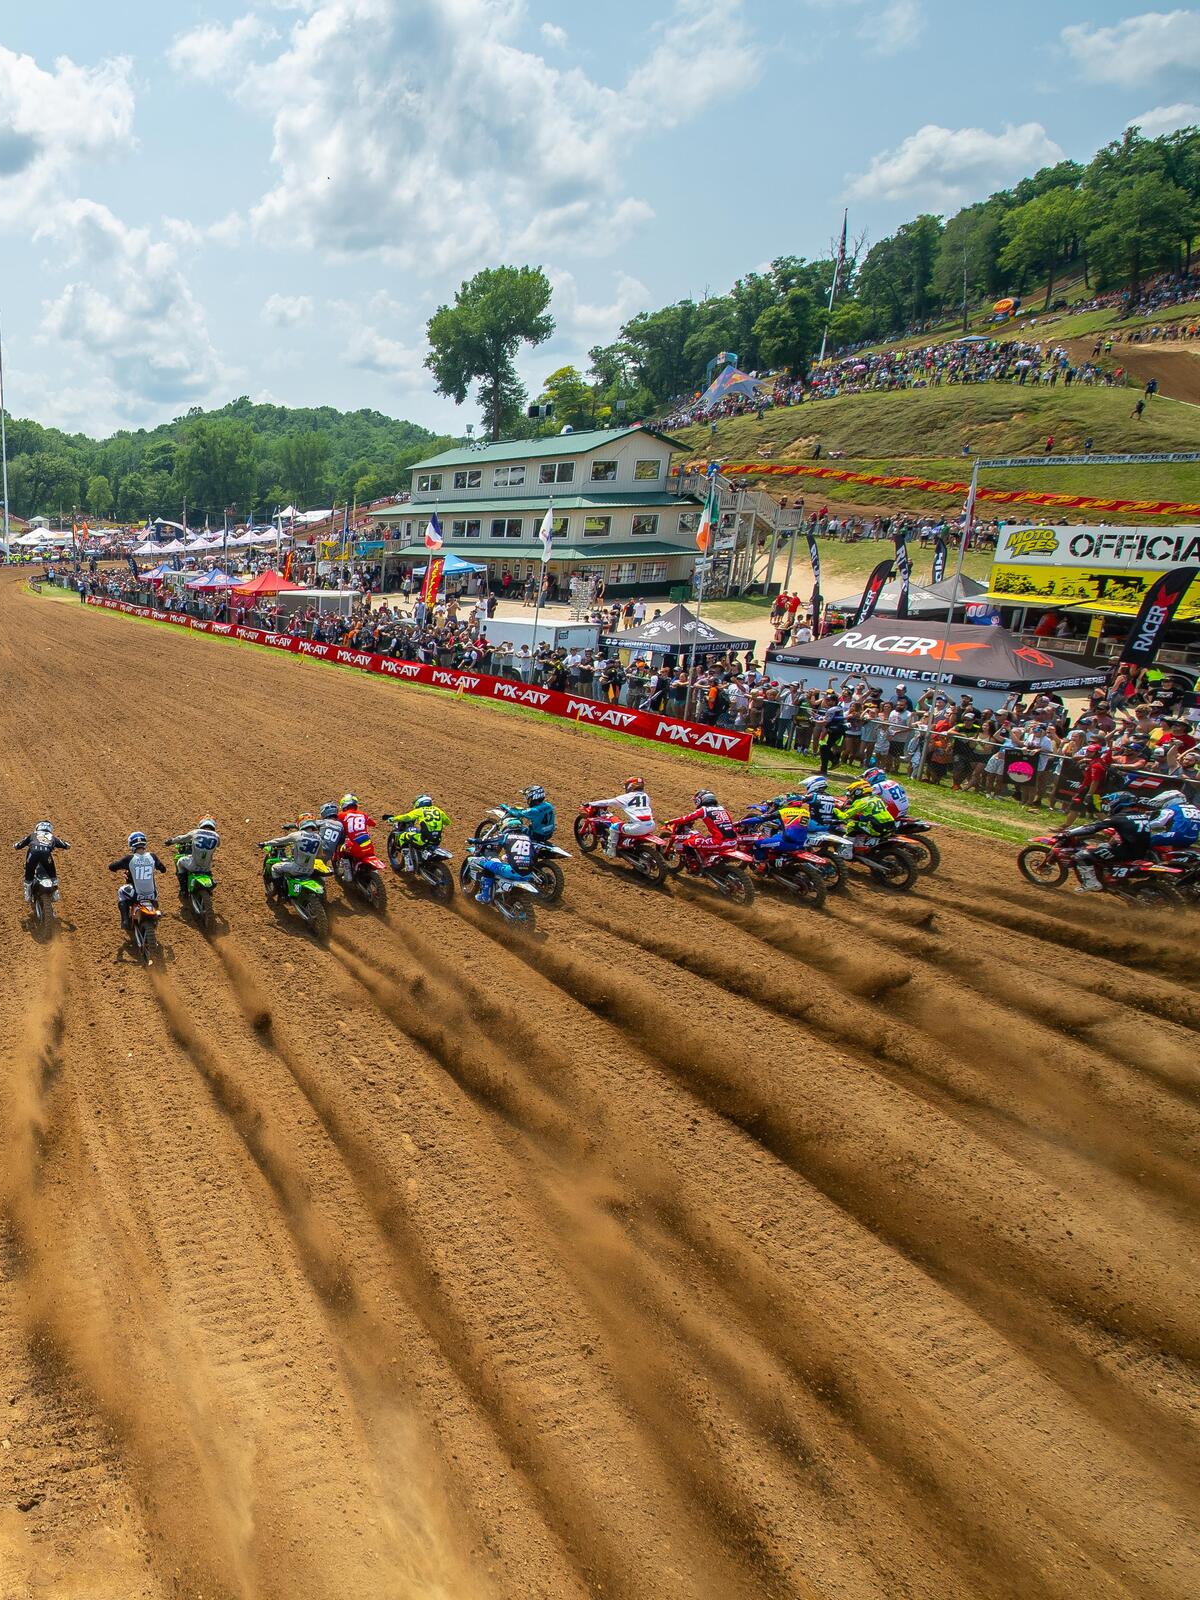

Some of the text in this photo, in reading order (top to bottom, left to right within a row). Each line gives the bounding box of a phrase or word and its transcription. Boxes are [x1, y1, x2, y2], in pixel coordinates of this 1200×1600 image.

[1007, 529, 1055, 548] MOTO
[1010, 538, 1058, 559] TEES
[730, 642, 750, 650] MOTO
[1029, 678, 1079, 691] SUBSCRIBE
[494, 682, 517, 697] MX
[522, 690, 551, 705] ATV
[567, 700, 595, 720] MX
[599, 712, 638, 727] ATV
[656, 721, 690, 743] MX
[695, 732, 742, 751] ATV
[628, 795, 647, 808] 41
[347, 816, 366, 833] 18
[424, 809, 441, 823] 59
[324, 828, 340, 843] 90
[511, 839, 531, 856] 48
[134, 866, 153, 880] 112
